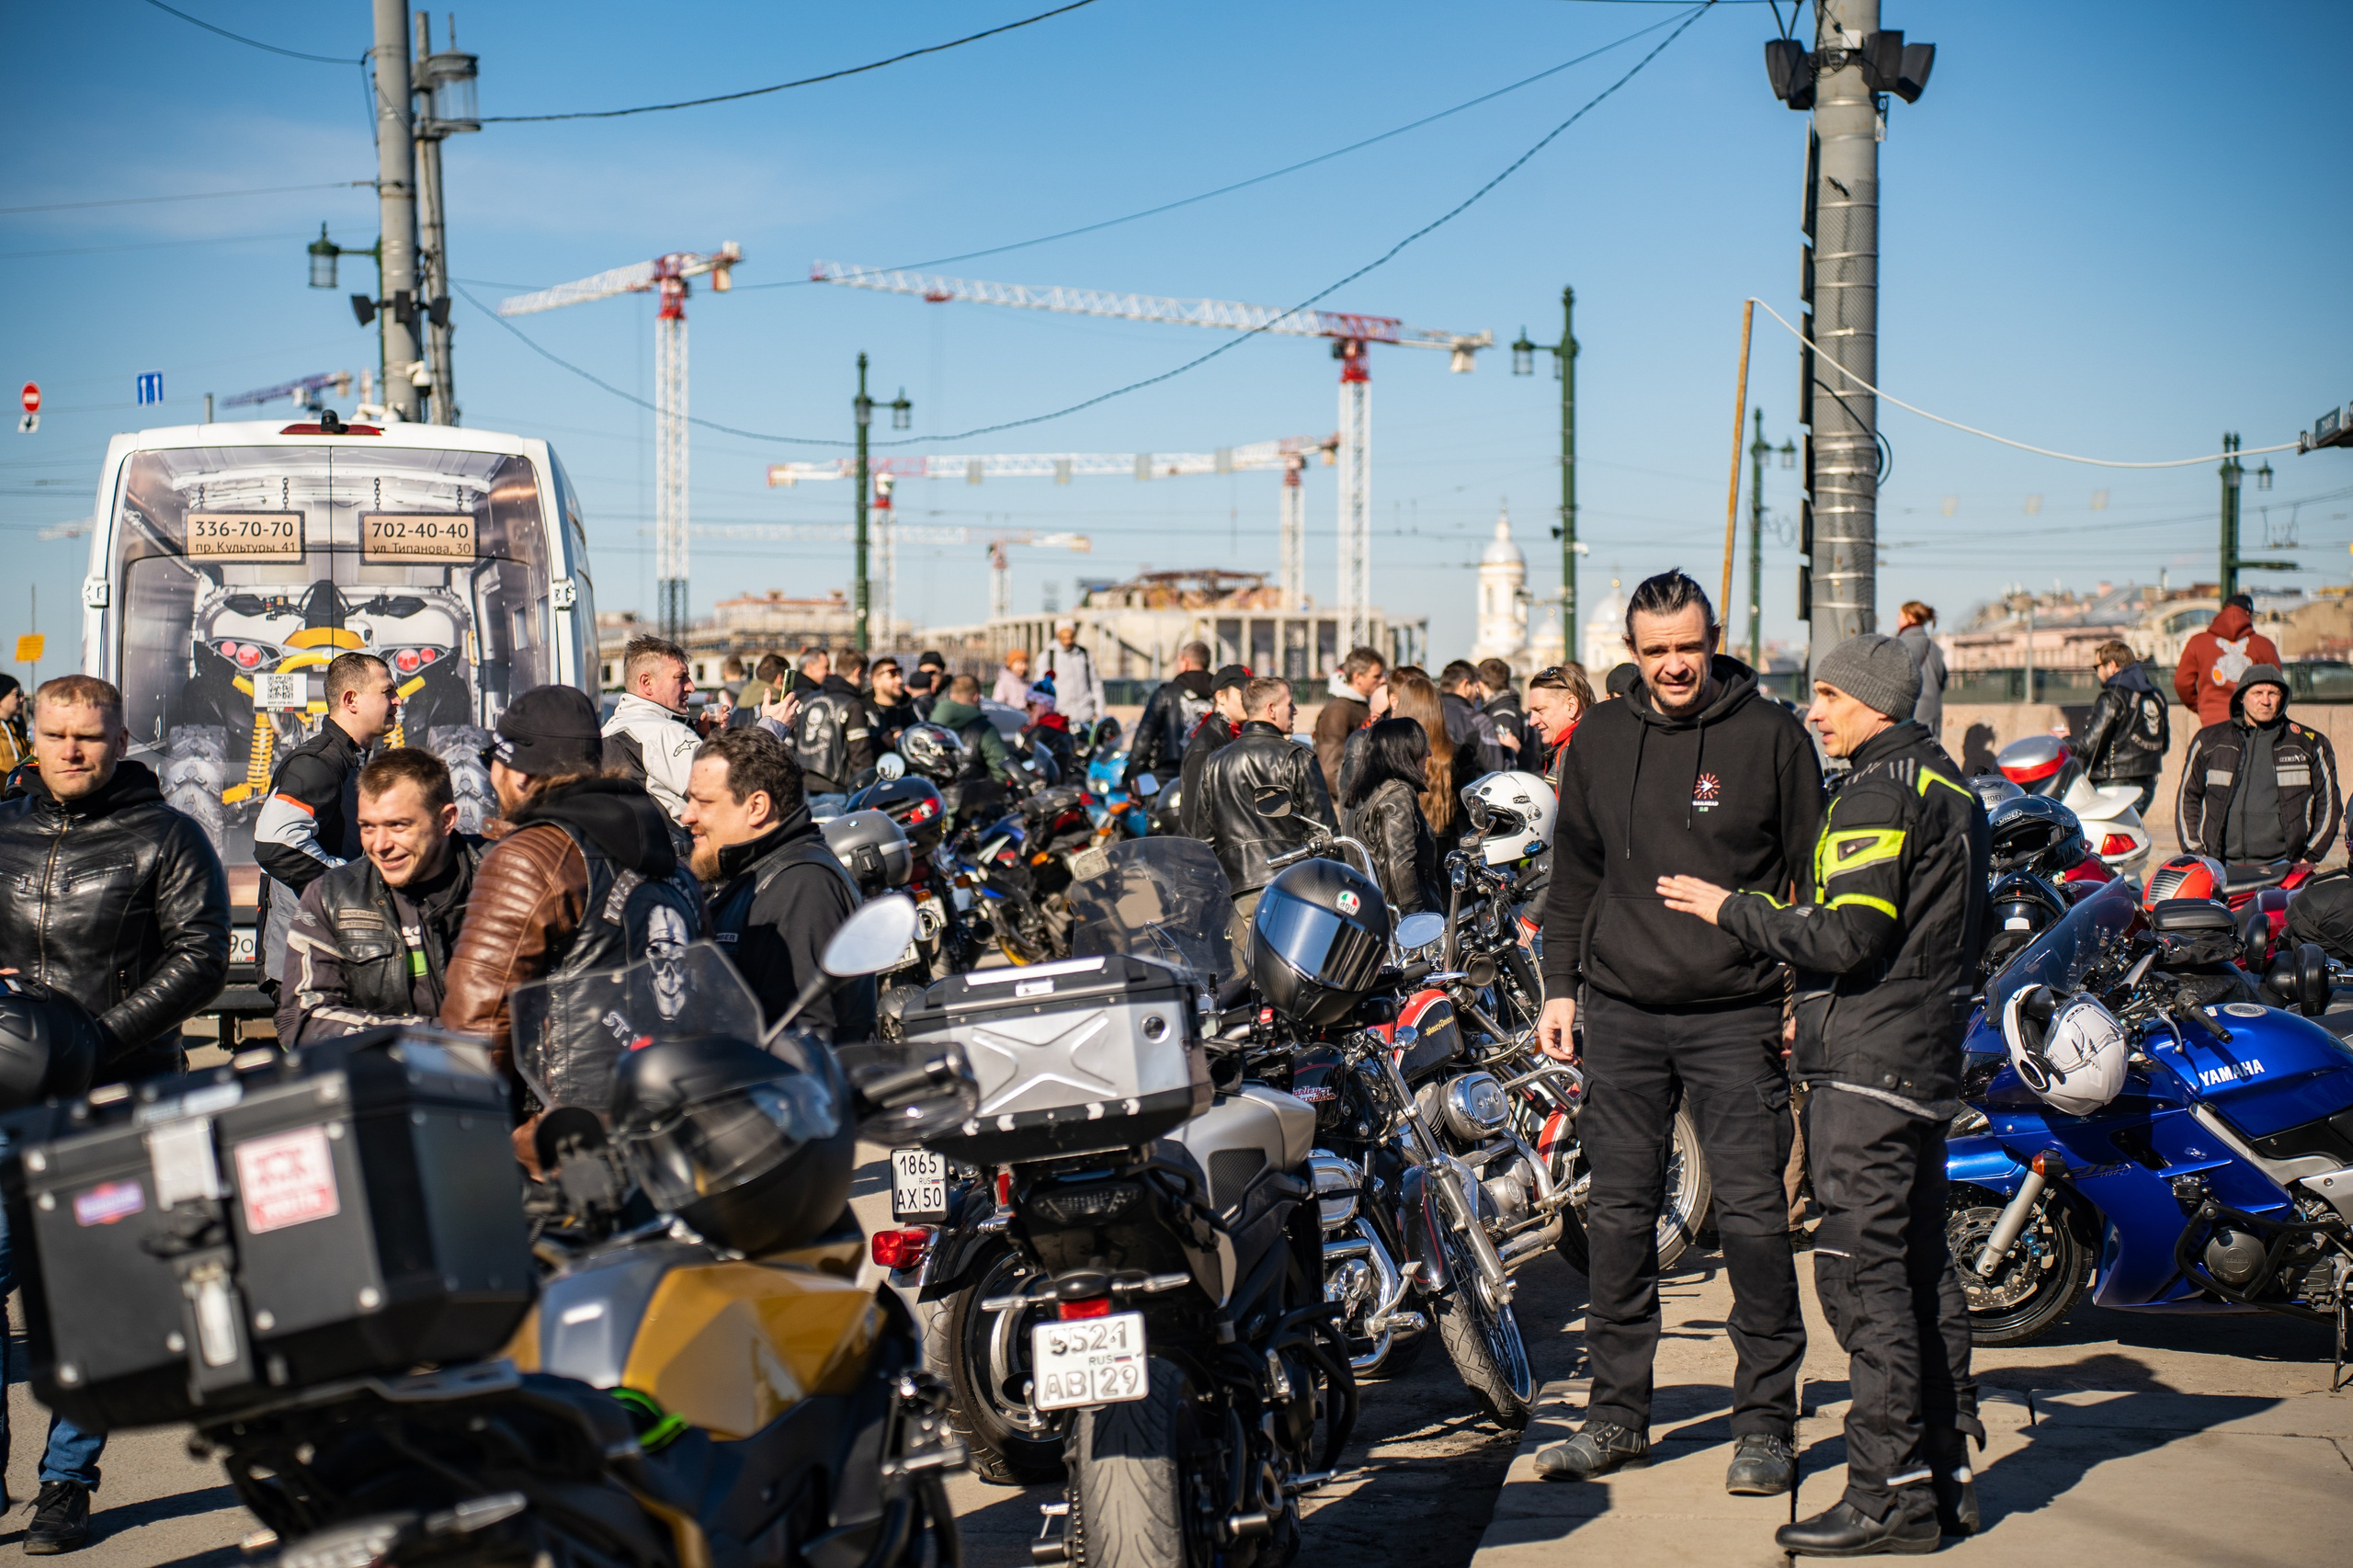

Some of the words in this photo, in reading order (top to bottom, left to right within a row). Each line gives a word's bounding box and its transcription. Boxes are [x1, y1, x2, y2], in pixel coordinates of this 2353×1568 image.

[195, 520, 293, 538] 336-70-70
[371, 522, 469, 539] 702-40-40
[195, 542, 214, 554] пр.
[281, 541, 295, 552] 41
[372, 544, 390, 555] ул.
[392, 542, 453, 555] Типанова,
[456, 543, 471, 554] 30
[1997, 810, 2019, 824] SHOEI
[602, 878, 632, 920] THE
[1339, 901, 1356, 913] agv
[2199, 1059, 2266, 1086] YAMAHA
[900, 1153, 937, 1176] 1865
[897, 1188, 917, 1210] AX
[924, 1187, 941, 1208] 50
[1050, 1322, 1127, 1356] 5521
[1088, 1356, 1114, 1366] RUS
[1043, 1371, 1086, 1401] AB
[1100, 1366, 1138, 1396] 29
